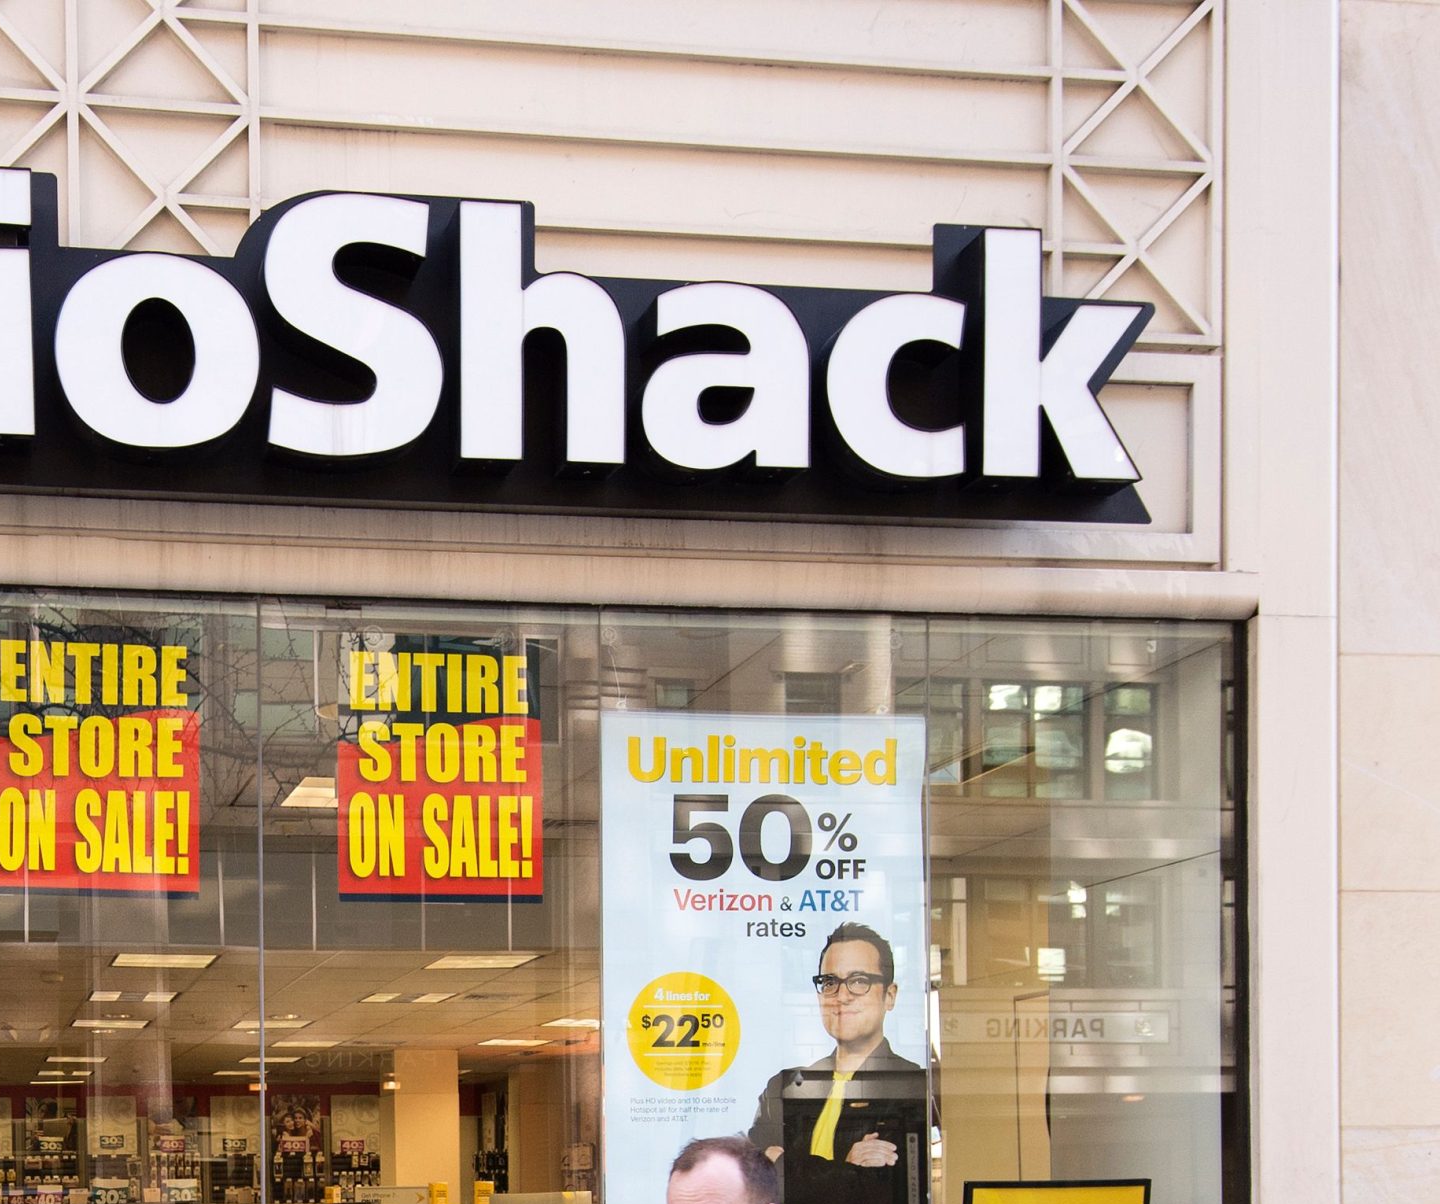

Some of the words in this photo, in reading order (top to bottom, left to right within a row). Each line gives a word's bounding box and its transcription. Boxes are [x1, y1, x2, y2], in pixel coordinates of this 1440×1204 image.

[0, 638, 188, 707] ENTIRE
[349, 650, 529, 714] ENTIRE
[8, 713, 185, 778] STORE
[358, 721, 528, 783] STORE
[627, 734, 898, 787] Unlimited
[75, 787, 190, 875] SALE!
[348, 791, 406, 878] ON
[422, 792, 534, 879] SALE!
[668, 793, 858, 882] 50%
[814, 858, 866, 880] OFF
[673, 888, 773, 912] Verizon
[780, 895, 793, 911] &
[798, 889, 864, 912] AT&T
[746, 919, 807, 938] rates
[654, 987, 665, 1001] 4
[666, 990, 693, 1001] lines
[694, 990, 710, 1001] for
